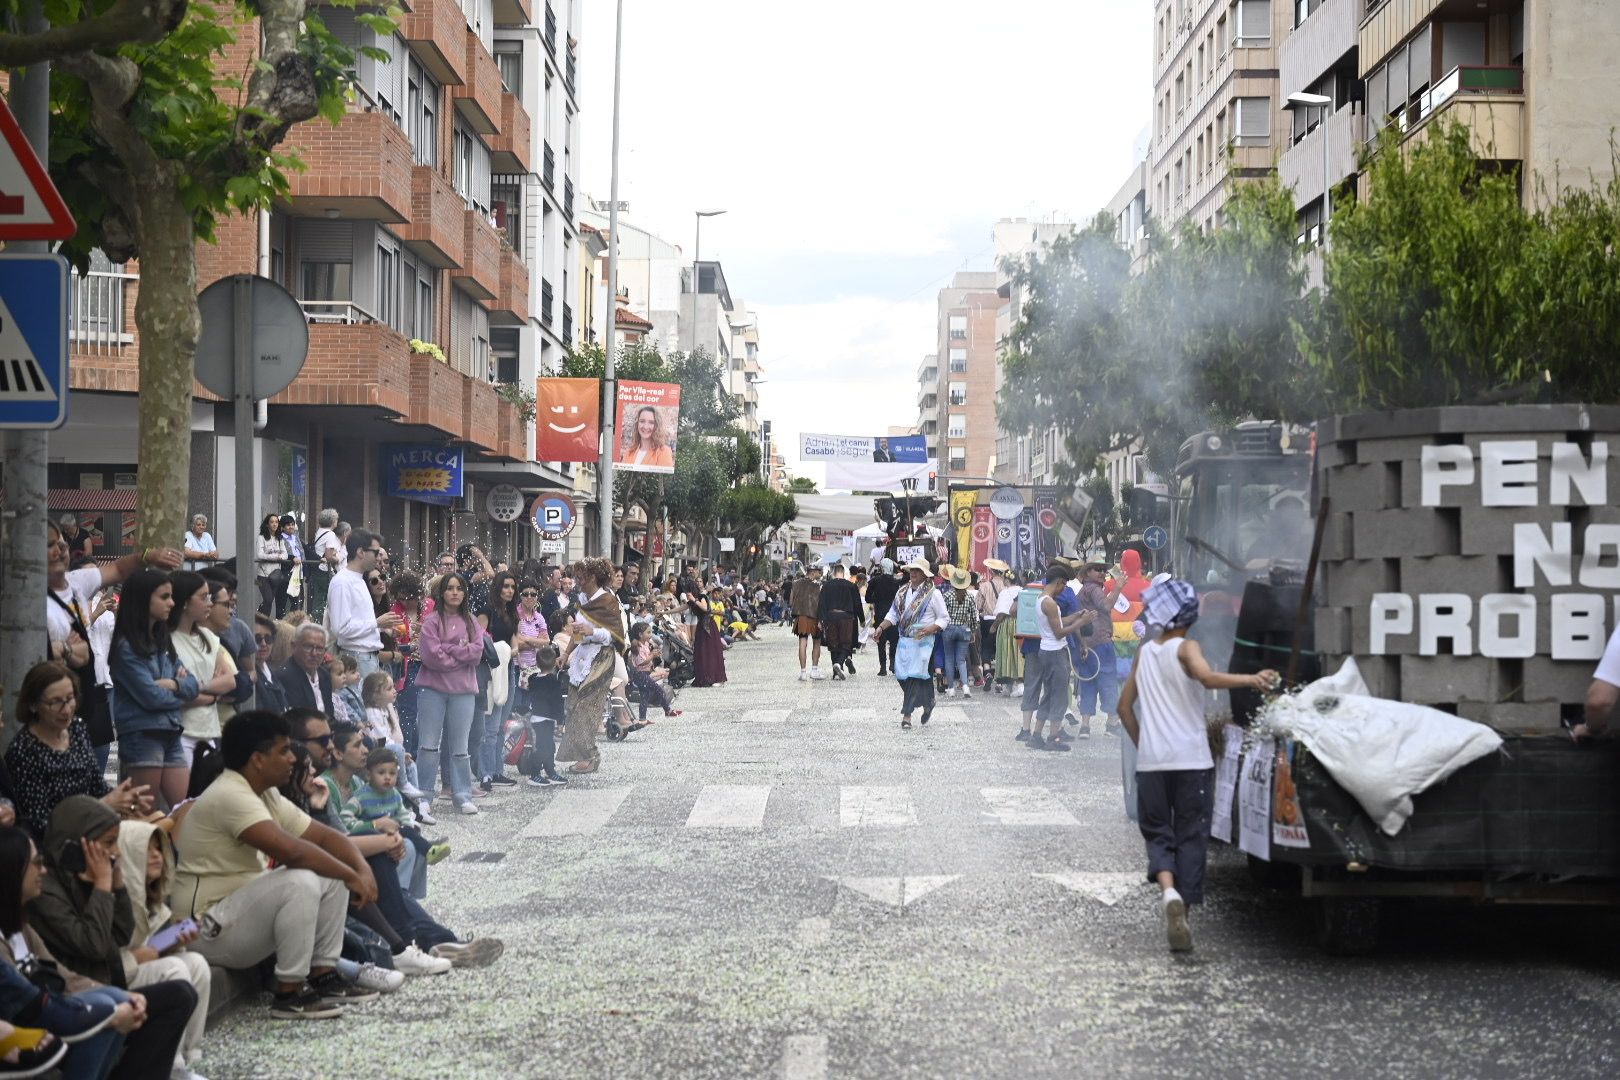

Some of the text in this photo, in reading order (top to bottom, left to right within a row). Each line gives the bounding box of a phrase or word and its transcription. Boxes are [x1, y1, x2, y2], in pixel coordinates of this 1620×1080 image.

[633, 386, 665, 396] Vila-real
[619, 393, 632, 401] des
[633, 394, 645, 402] del
[848, 439, 869, 447] canvi
[805, 447, 835, 455] Casabó
[392, 449, 458, 469] MERCA
[546, 509, 560, 522] P
[531, 516, 544, 536] CARGA
[551, 516, 577, 540] DESCARGA
